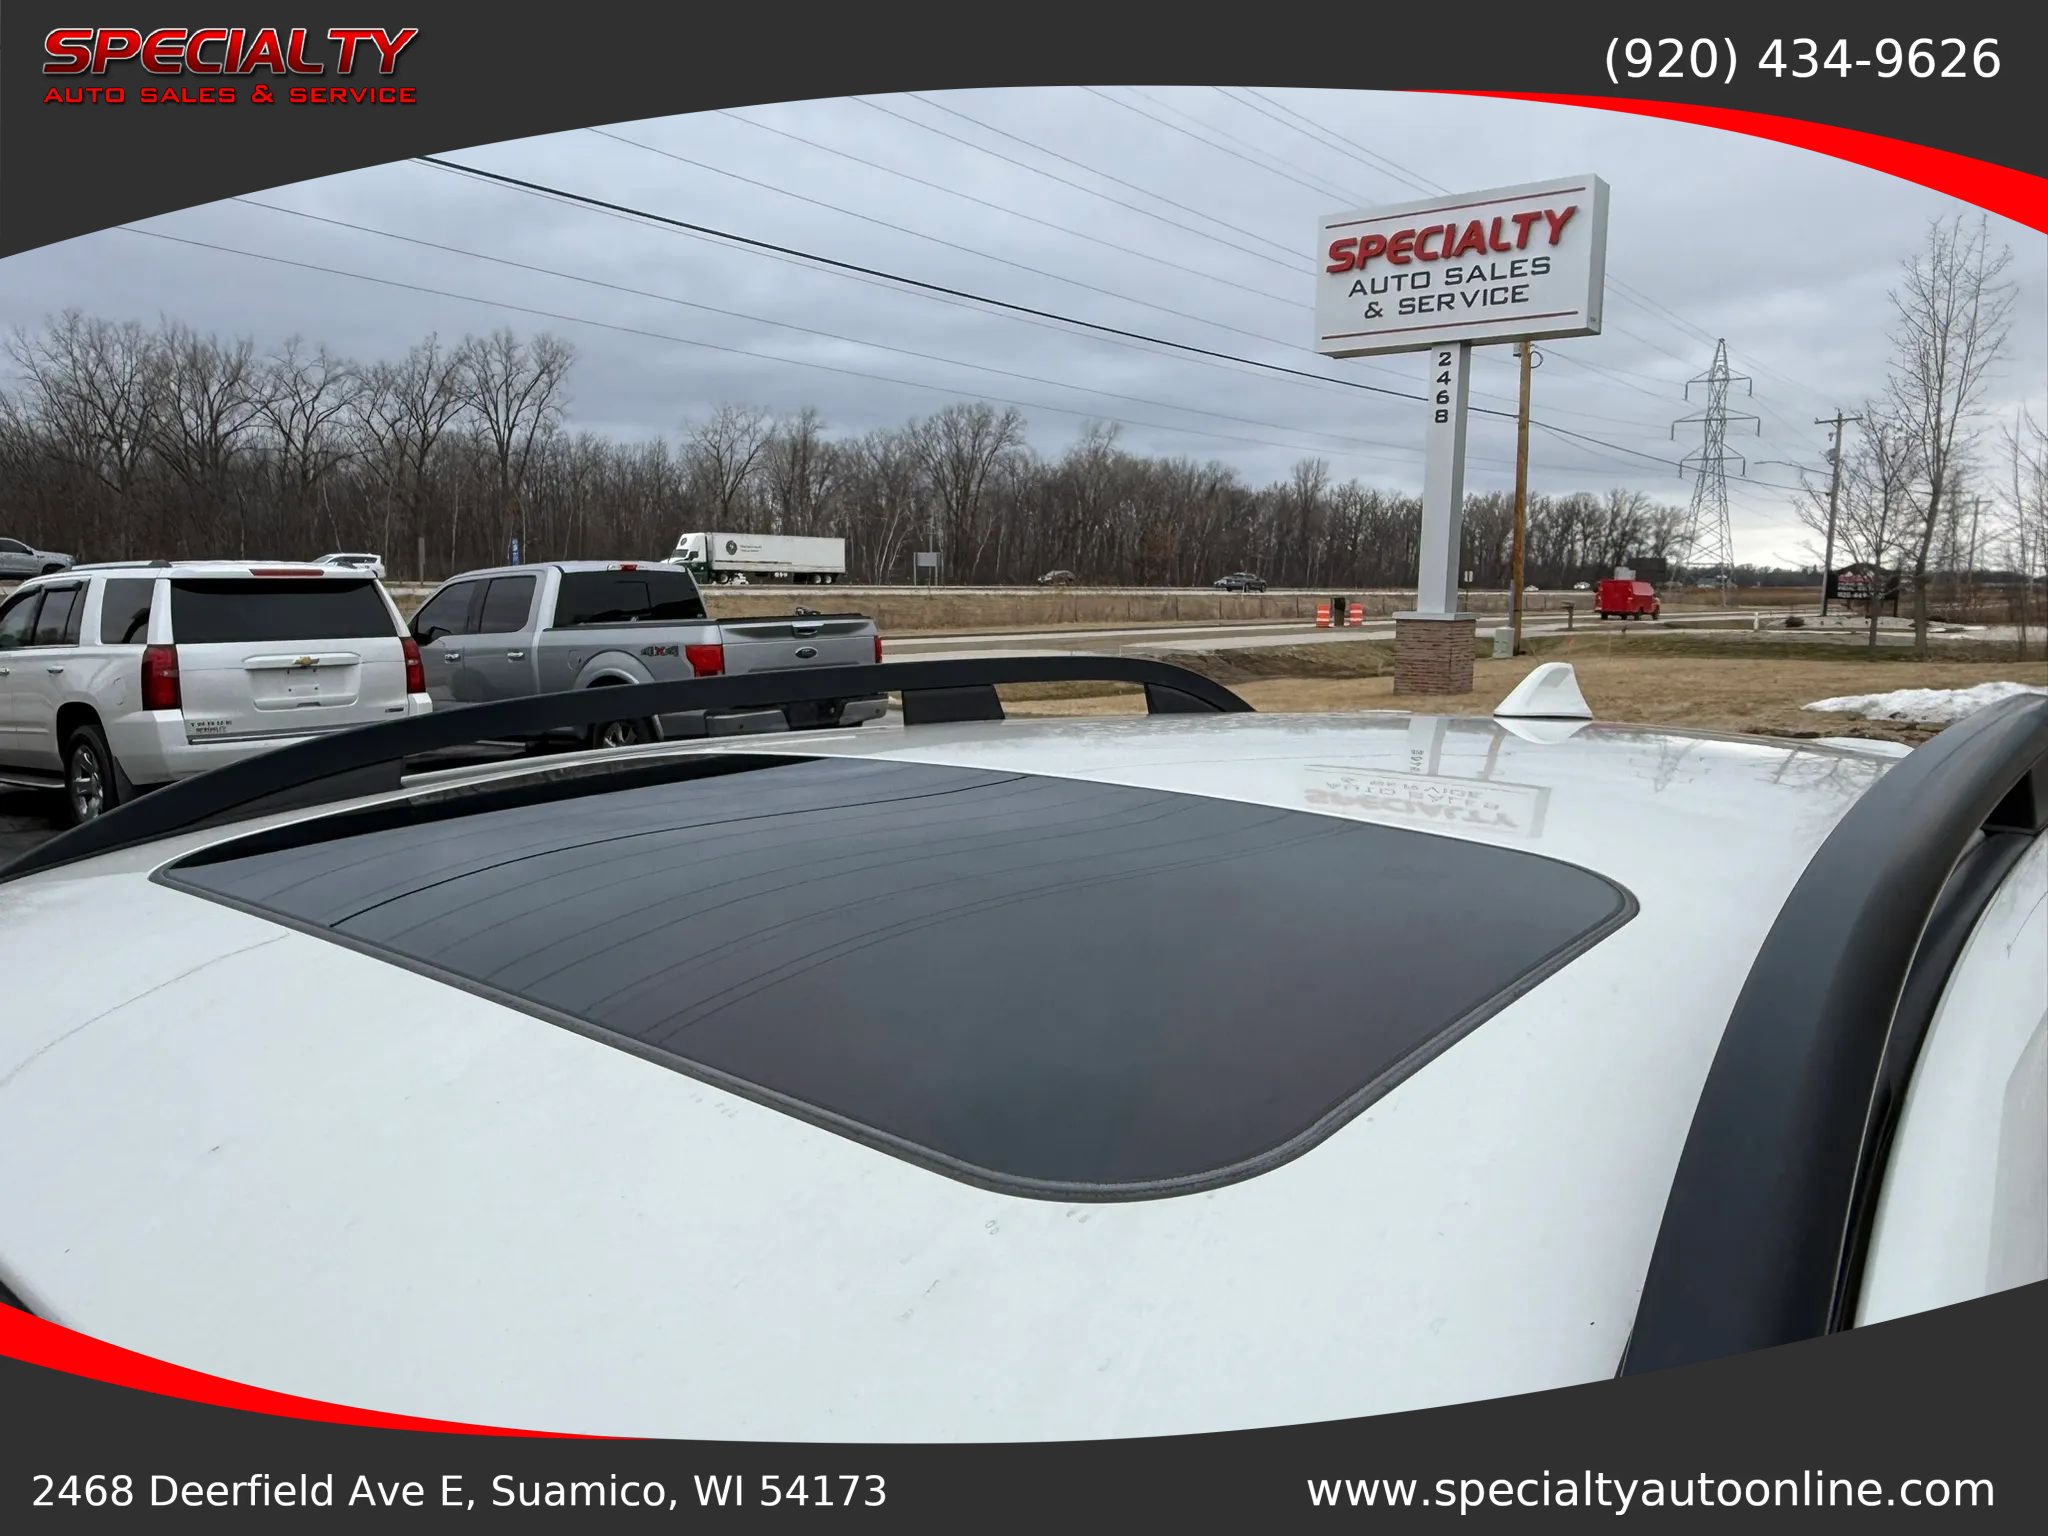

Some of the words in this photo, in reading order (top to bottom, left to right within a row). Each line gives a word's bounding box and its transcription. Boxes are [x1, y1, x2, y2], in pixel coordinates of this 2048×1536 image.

[1326, 205, 1578, 273] SPECIALTY
[1348, 271, 1431, 298] AUTO
[1444, 256, 1551, 286] SALES
[1364, 301, 1384, 319] &
[1398, 284, 1530, 315] SERVICE
